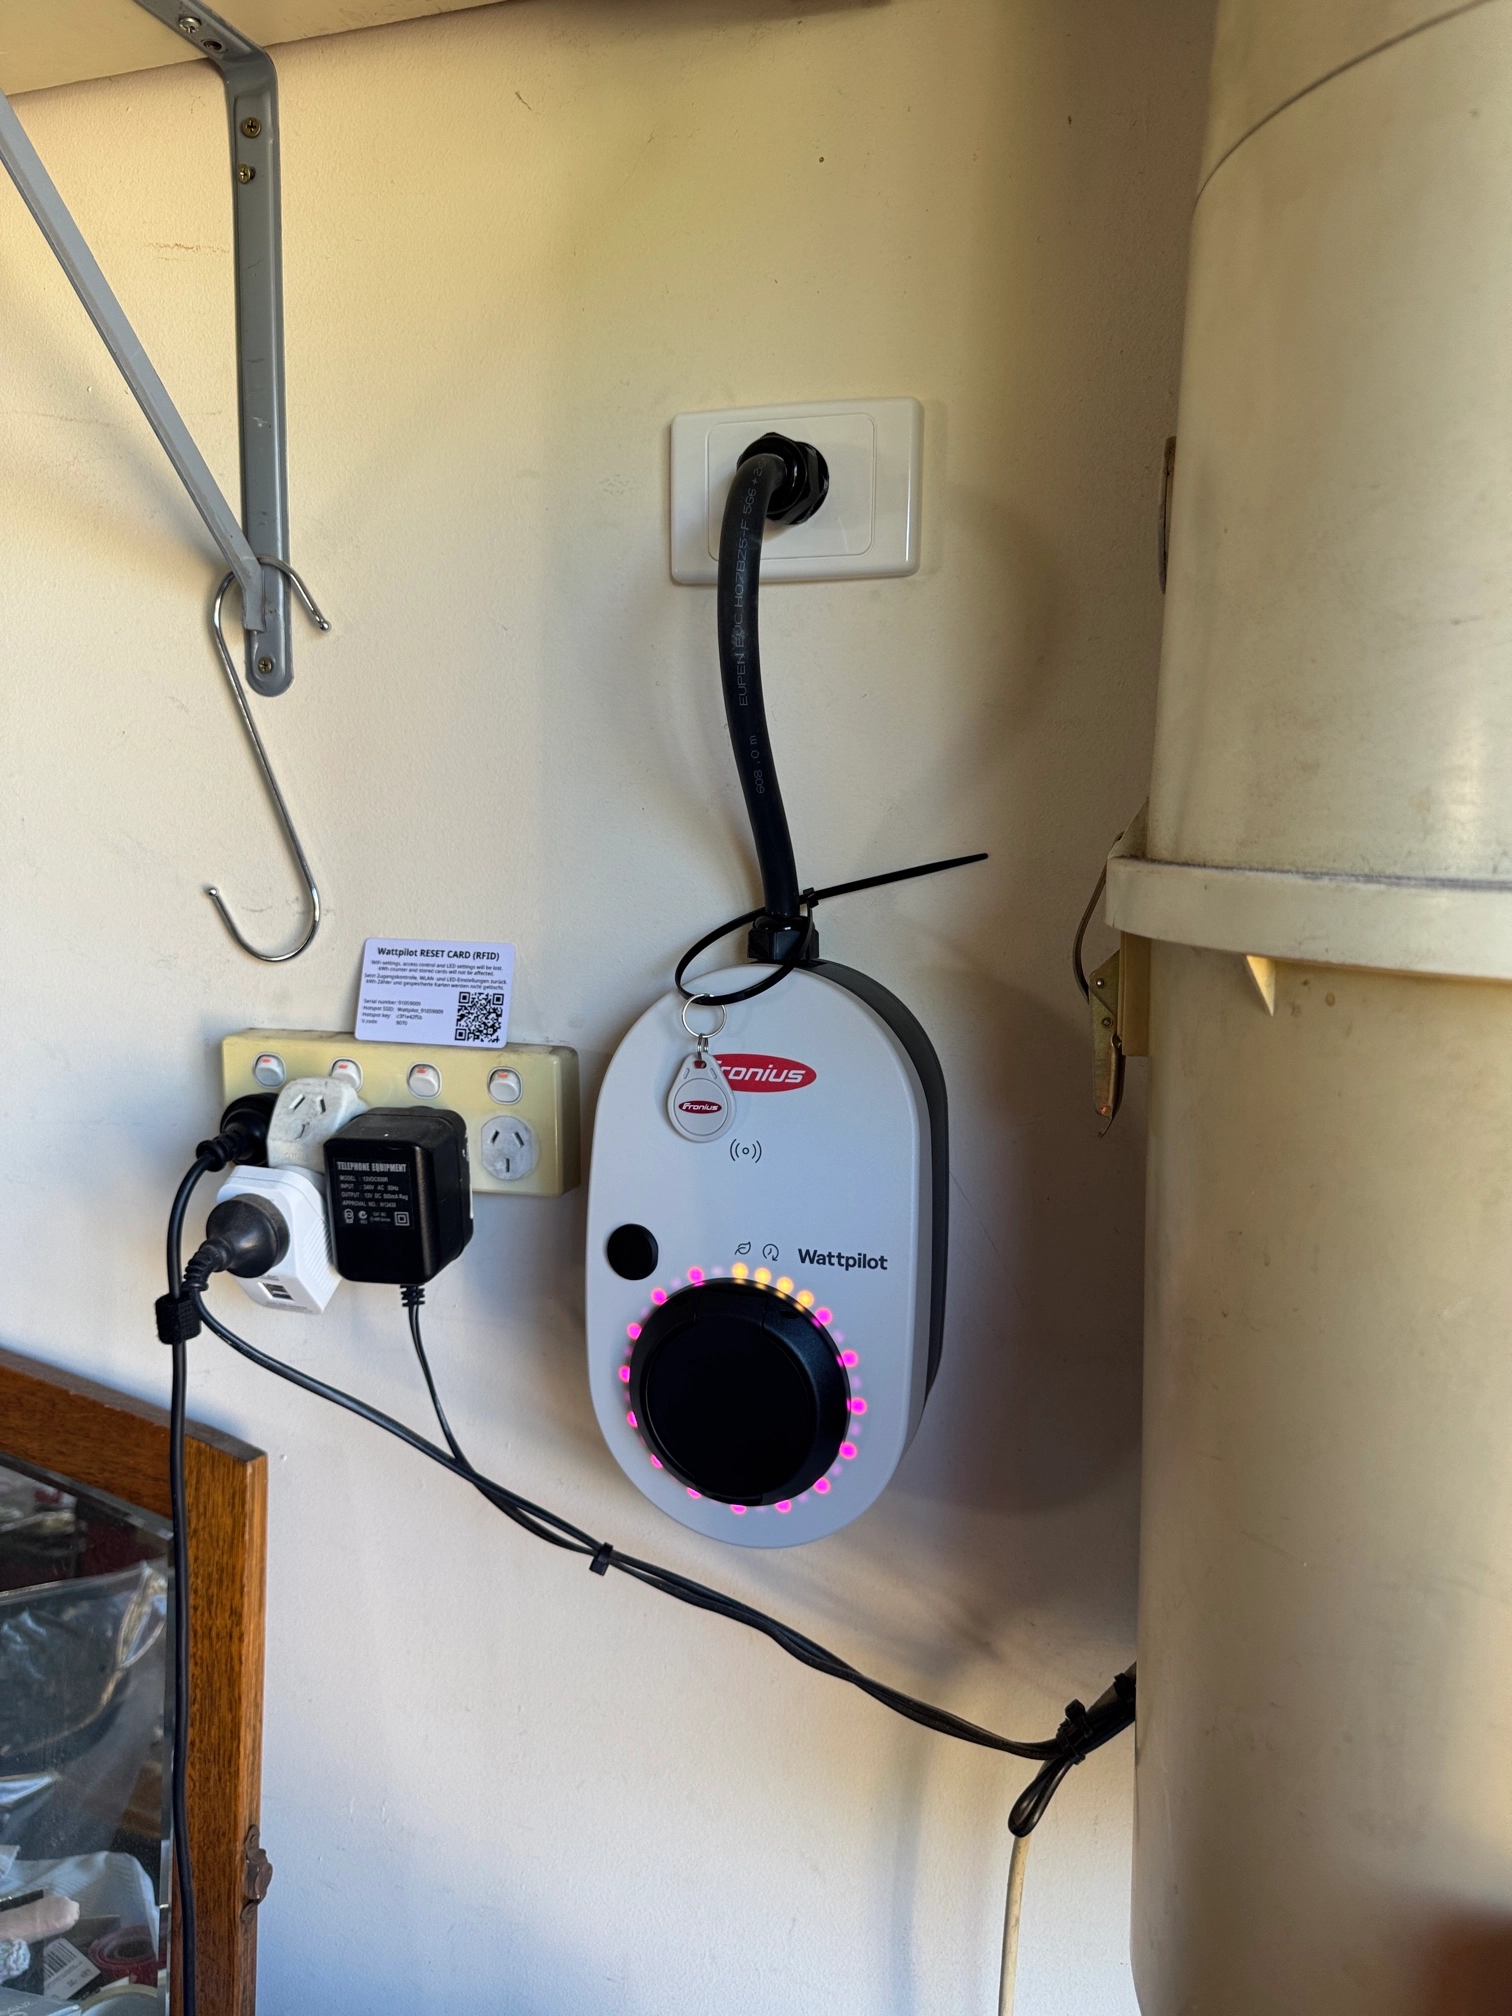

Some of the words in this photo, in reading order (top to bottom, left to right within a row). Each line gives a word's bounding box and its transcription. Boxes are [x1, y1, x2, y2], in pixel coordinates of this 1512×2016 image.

[737, 653, 748, 706] EUPEN
[377, 947, 418, 958] Wattpilot
[420, 949, 445, 958] RESET
[447, 950, 471, 959] CARD
[472, 951, 500, 962] (RFID)
[716, 1061, 806, 1083] ronius
[682, 1102, 719, 1111] Fronius
[337, 1161, 370, 1171] TELEPHONE
[371, 1163, 407, 1173] EQUIPMENT
[798, 1248, 888, 1271] Wattpilot
